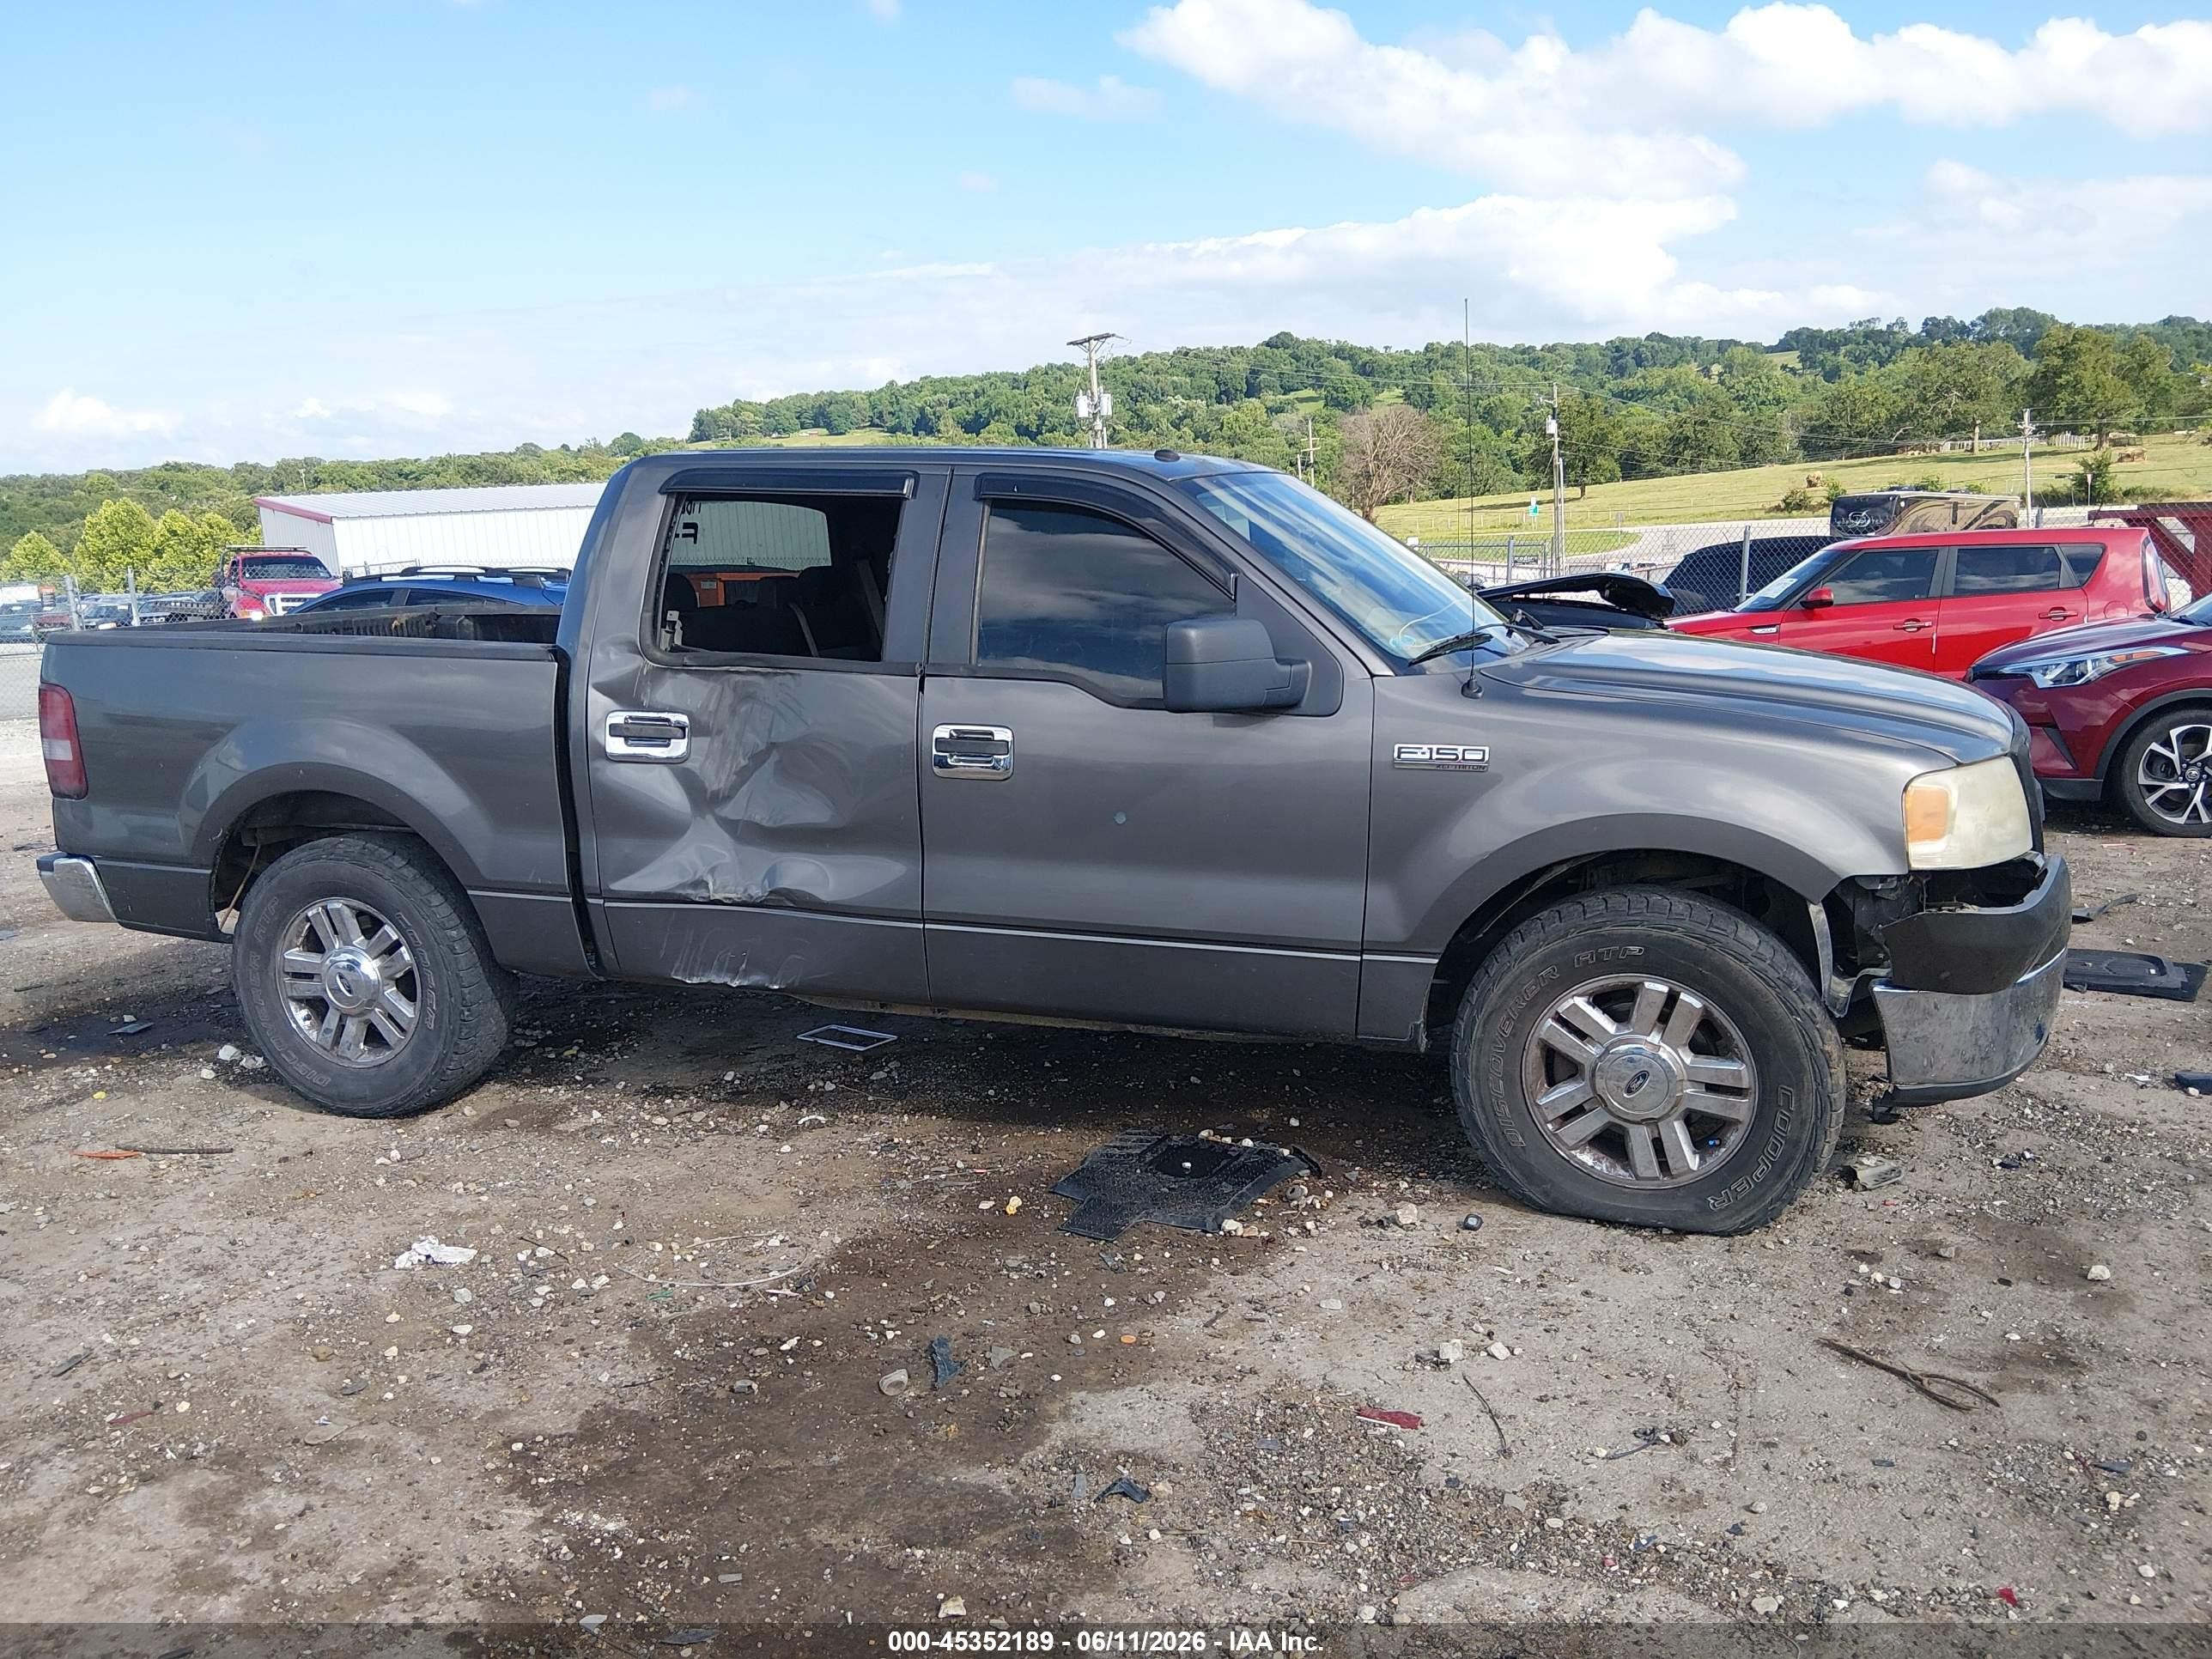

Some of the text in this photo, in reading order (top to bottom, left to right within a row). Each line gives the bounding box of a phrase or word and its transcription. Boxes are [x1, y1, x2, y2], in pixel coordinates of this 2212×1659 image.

[1396, 746, 1486, 763] F-150
[395, 912, 436, 1030] COOPER
[1490, 945, 1645, 1147] DISCOVERER ATP
[1706, 1085, 1795, 1211] COOPER
